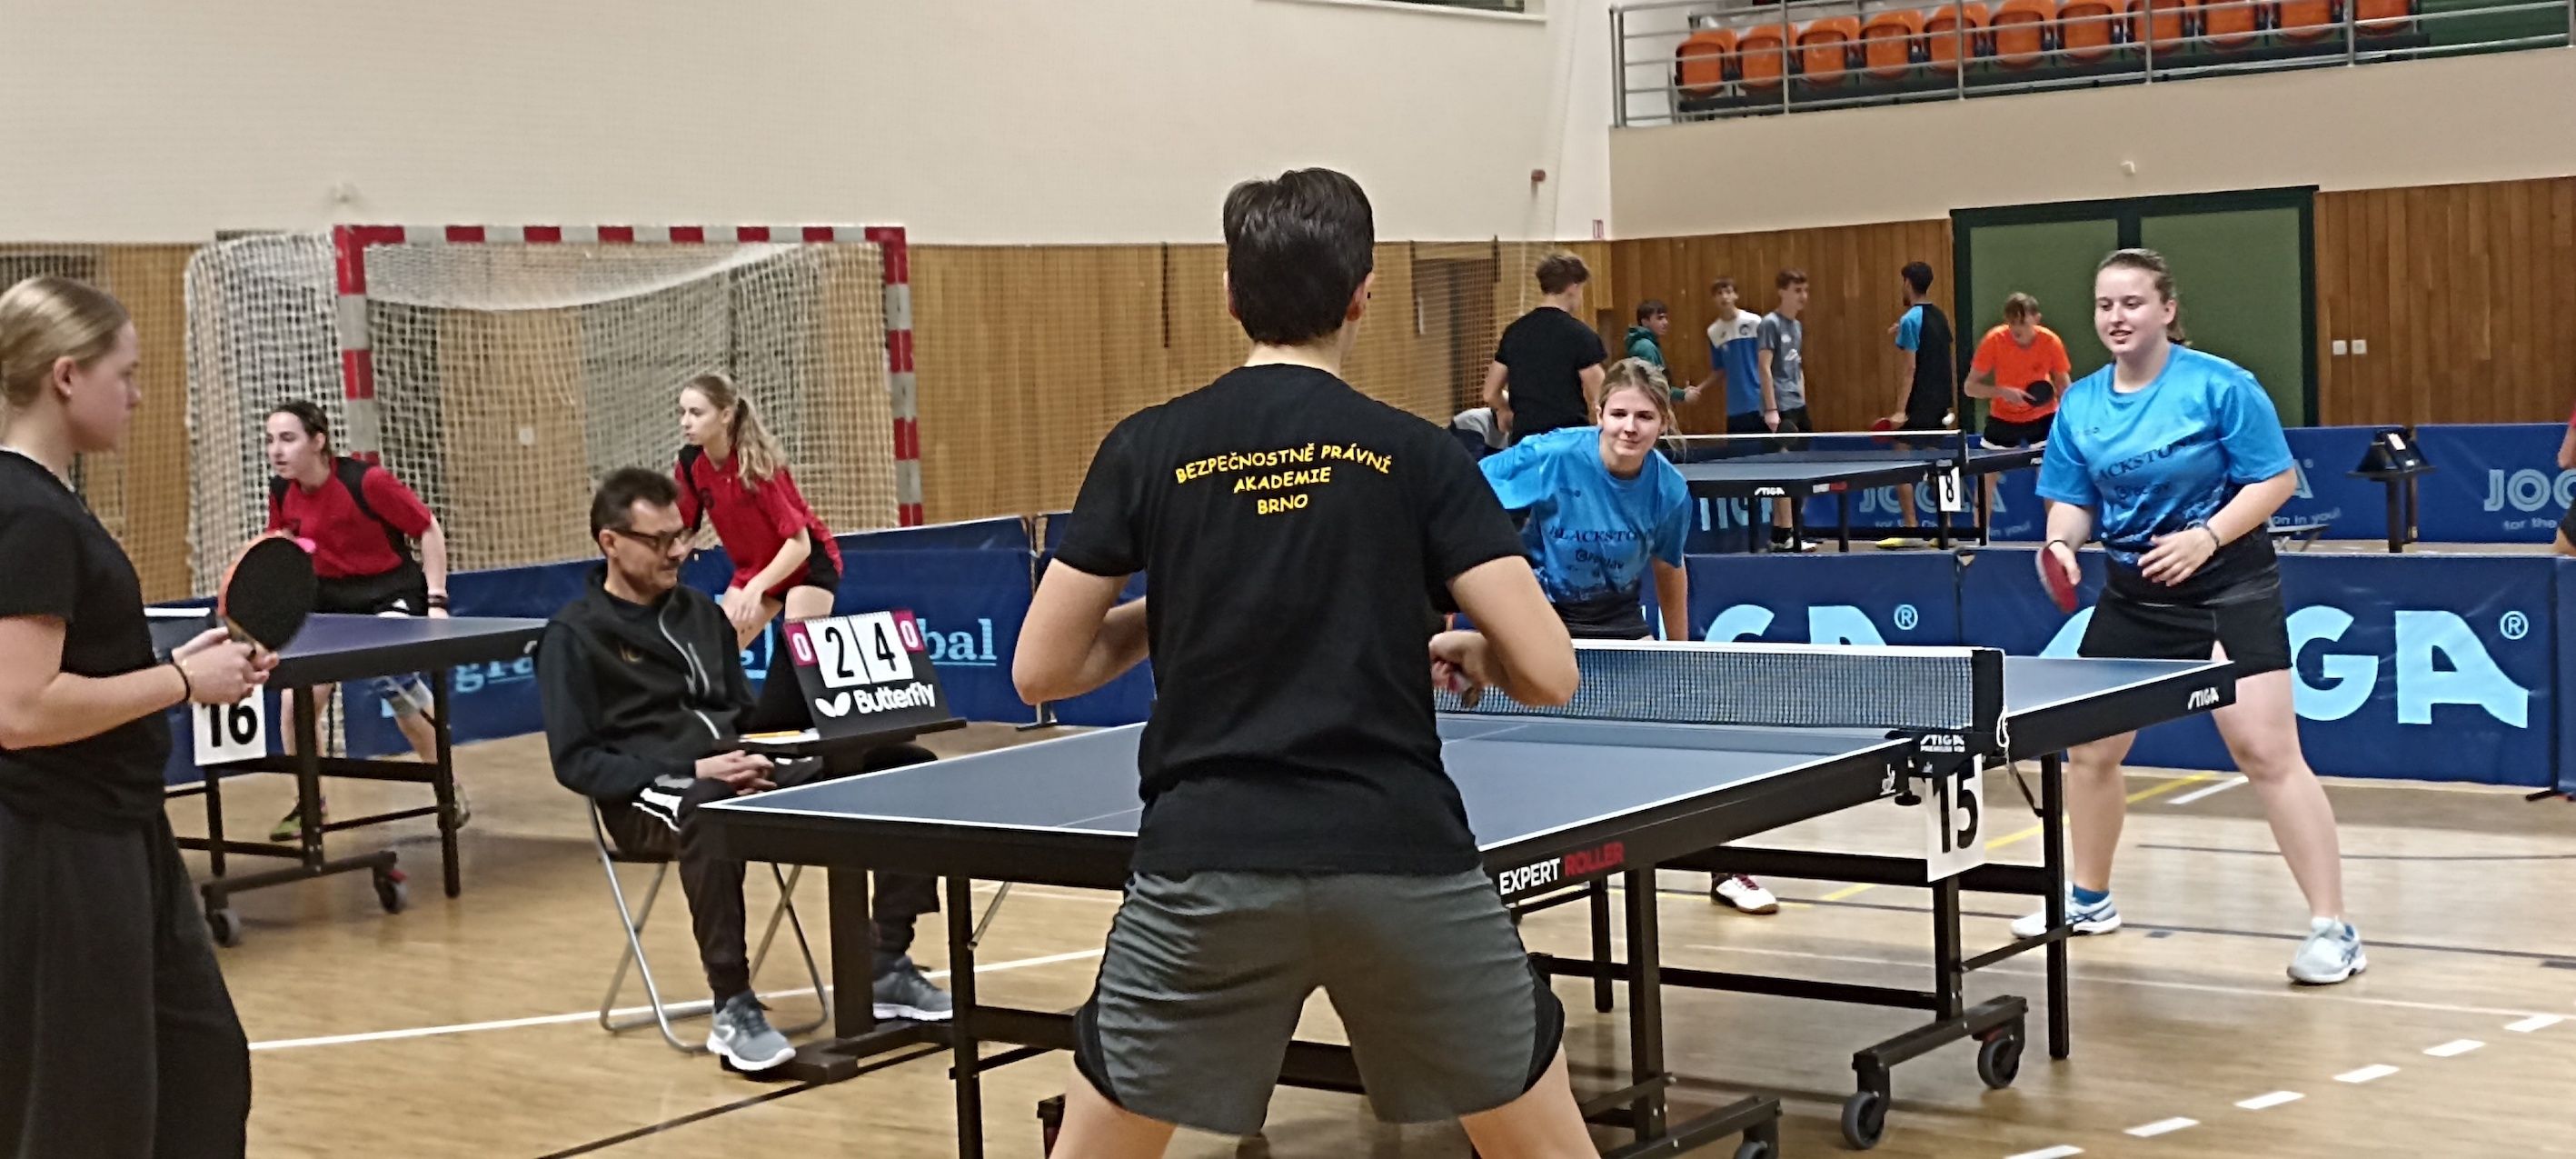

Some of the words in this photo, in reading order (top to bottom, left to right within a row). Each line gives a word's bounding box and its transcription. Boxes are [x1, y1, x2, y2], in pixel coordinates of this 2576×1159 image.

[1175, 443, 1315, 484] BEZPEČNOSTNĚ
[1321, 443, 1392, 474] PRÁVNÍ
[1233, 466, 1332, 494] AKADEMIE
[1257, 494, 1308, 515] BRNO
[825, 626, 854, 678] 2
[874, 622, 896, 672] 4
[853, 682, 936, 714] Butterfly
[2187, 686, 2220, 710] STIGA
[201, 703, 258, 747] 16
[1920, 734, 1964, 745] STIGA
[1932, 767, 1978, 854] 15
[1499, 857, 1561, 895] EXPERT
[1564, 841, 1625, 878] ROLLER
